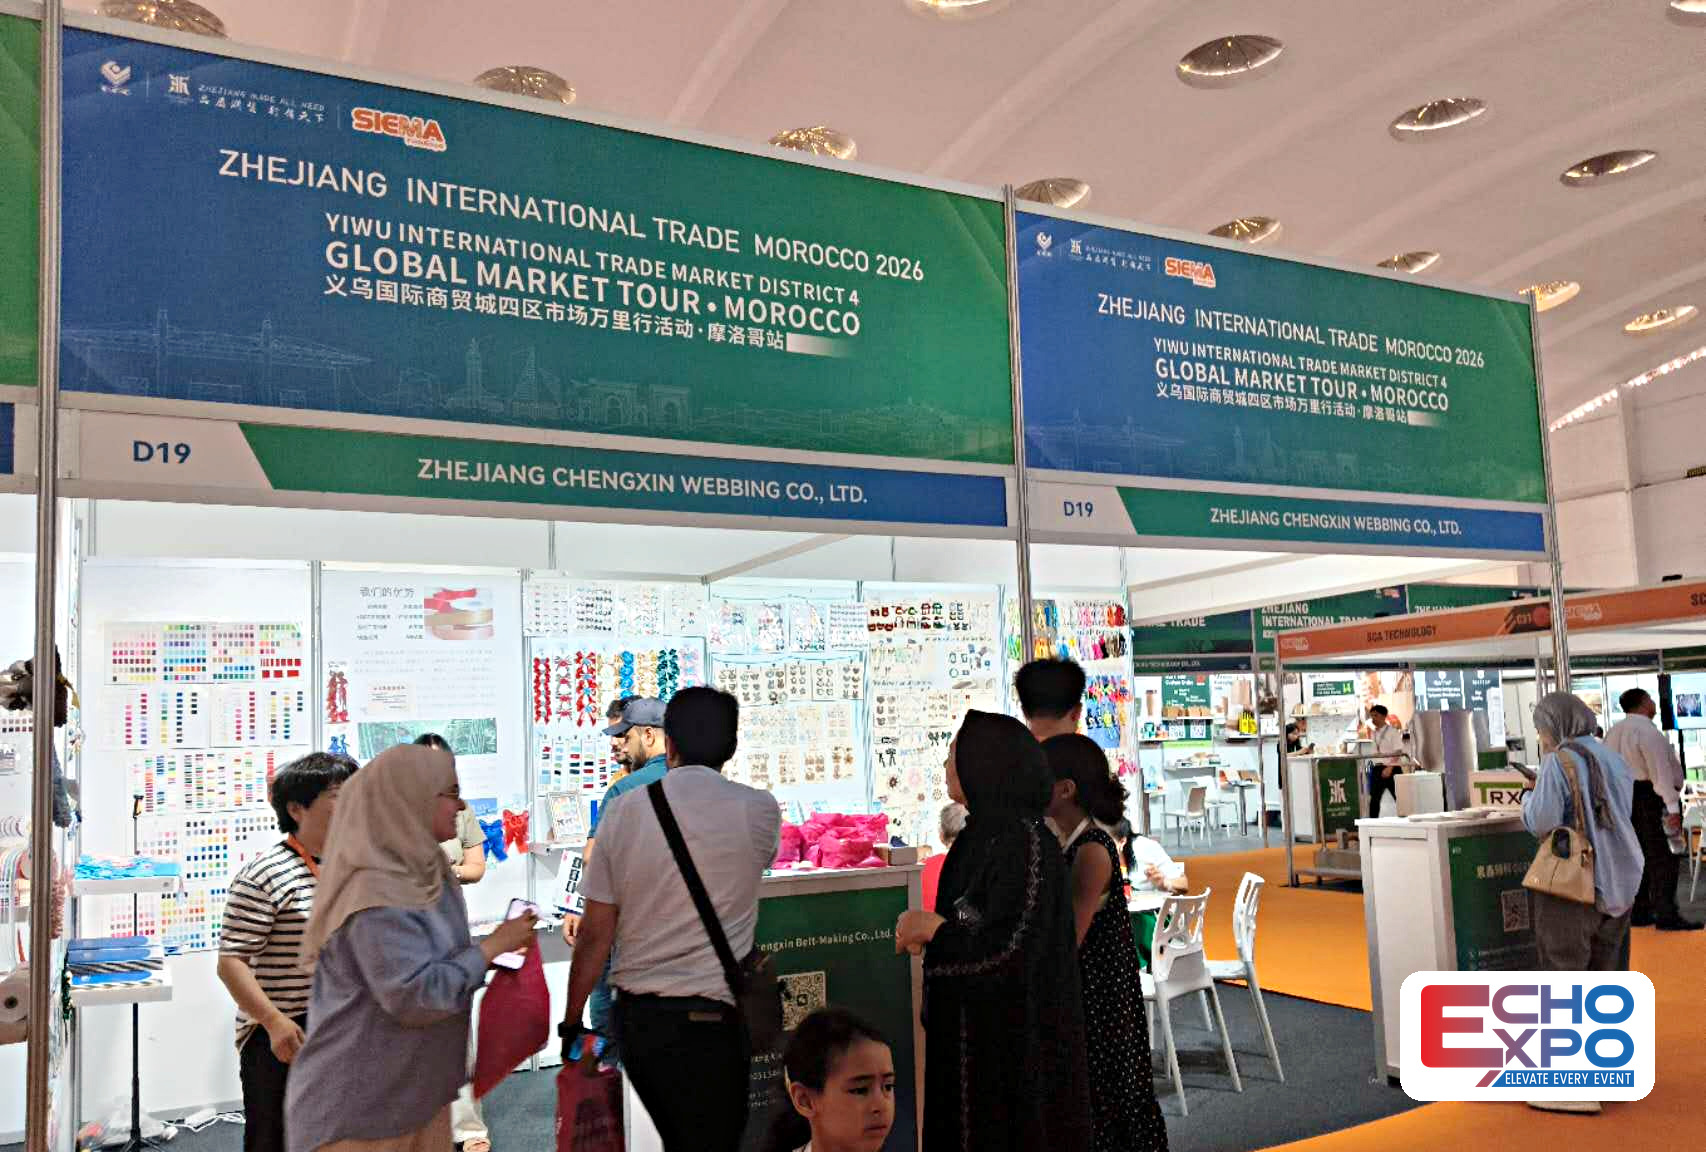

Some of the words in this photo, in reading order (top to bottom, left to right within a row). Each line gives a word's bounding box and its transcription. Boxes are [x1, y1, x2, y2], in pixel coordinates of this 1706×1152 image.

[352, 108, 445, 143] SIEMA
[219, 148, 388, 199] ZHEJIANG
[407, 177, 646, 239] INTERNATIONAL
[652, 217, 740, 254] TRADE
[755, 233, 870, 273] MOROCCO
[875, 254, 925, 283] 2026
[326, 212, 392, 240] YIWU
[399, 223, 592, 269] INTERNATIONAL
[595, 251, 667, 280] TRADE
[671, 263, 755, 291] MARKET
[760, 275, 845, 305] DISTRICT
[848, 289, 861, 307] 4
[1165, 257, 1215, 282] SIEMA
[325, 240, 468, 285] GLOBAL
[477, 261, 610, 303] MARKET
[616, 279, 701, 316] TOUR
[724, 295, 861, 337] MOROCCO
[324, 274, 785, 352] 义乌国际商贸城四区市场万里行活动·摩洛哥站
[1097, 292, 1187, 326] ZHEJIANG
[1194, 308, 1326, 346] INTERNATIONAL
[1327, 327, 1379, 353] TRADE
[1385, 337, 1453, 364] MOROCCO
[1454, 348, 1485, 369] 2026
[1153, 336, 1189, 356] YIWU
[1192, 343, 1297, 370] INTERNATIONAL
[1298, 356, 1338, 375] TRADE
[1340, 362, 1387, 381] MARKET
[1389, 368, 1439, 388] DISTRICT
[1440, 376, 1448, 389] 4
[1155, 357, 1231, 386] GLOBAL
[1234, 367, 1307, 395] MARKET
[1310, 376, 1358, 401] TOUR
[1370, 383, 1449, 412] MOROCCO
[133, 440, 191, 464] D19
[417, 458, 546, 486] ZHEJIANG
[552, 467, 673, 494] CHENGXIN
[680, 474, 780, 500] WEBBING
[785, 481, 824, 505] CO.,
[829, 483, 868, 504] LTD.
[1063, 501, 1093, 517] D19
[1210, 507, 1280, 526] ZHEJIANG
[1282, 511, 1351, 530] CHENGXIN
[1353, 516, 1411, 533] WEBBING
[1413, 519, 1437, 536] CO.,
[1438, 520, 1462, 536] LTD.
[1262, 615, 1336, 628] INTERNATIONAL
[1385, 625, 1437, 640] TECHNOLOGY
[796, 931, 854, 948] Belt-Making
